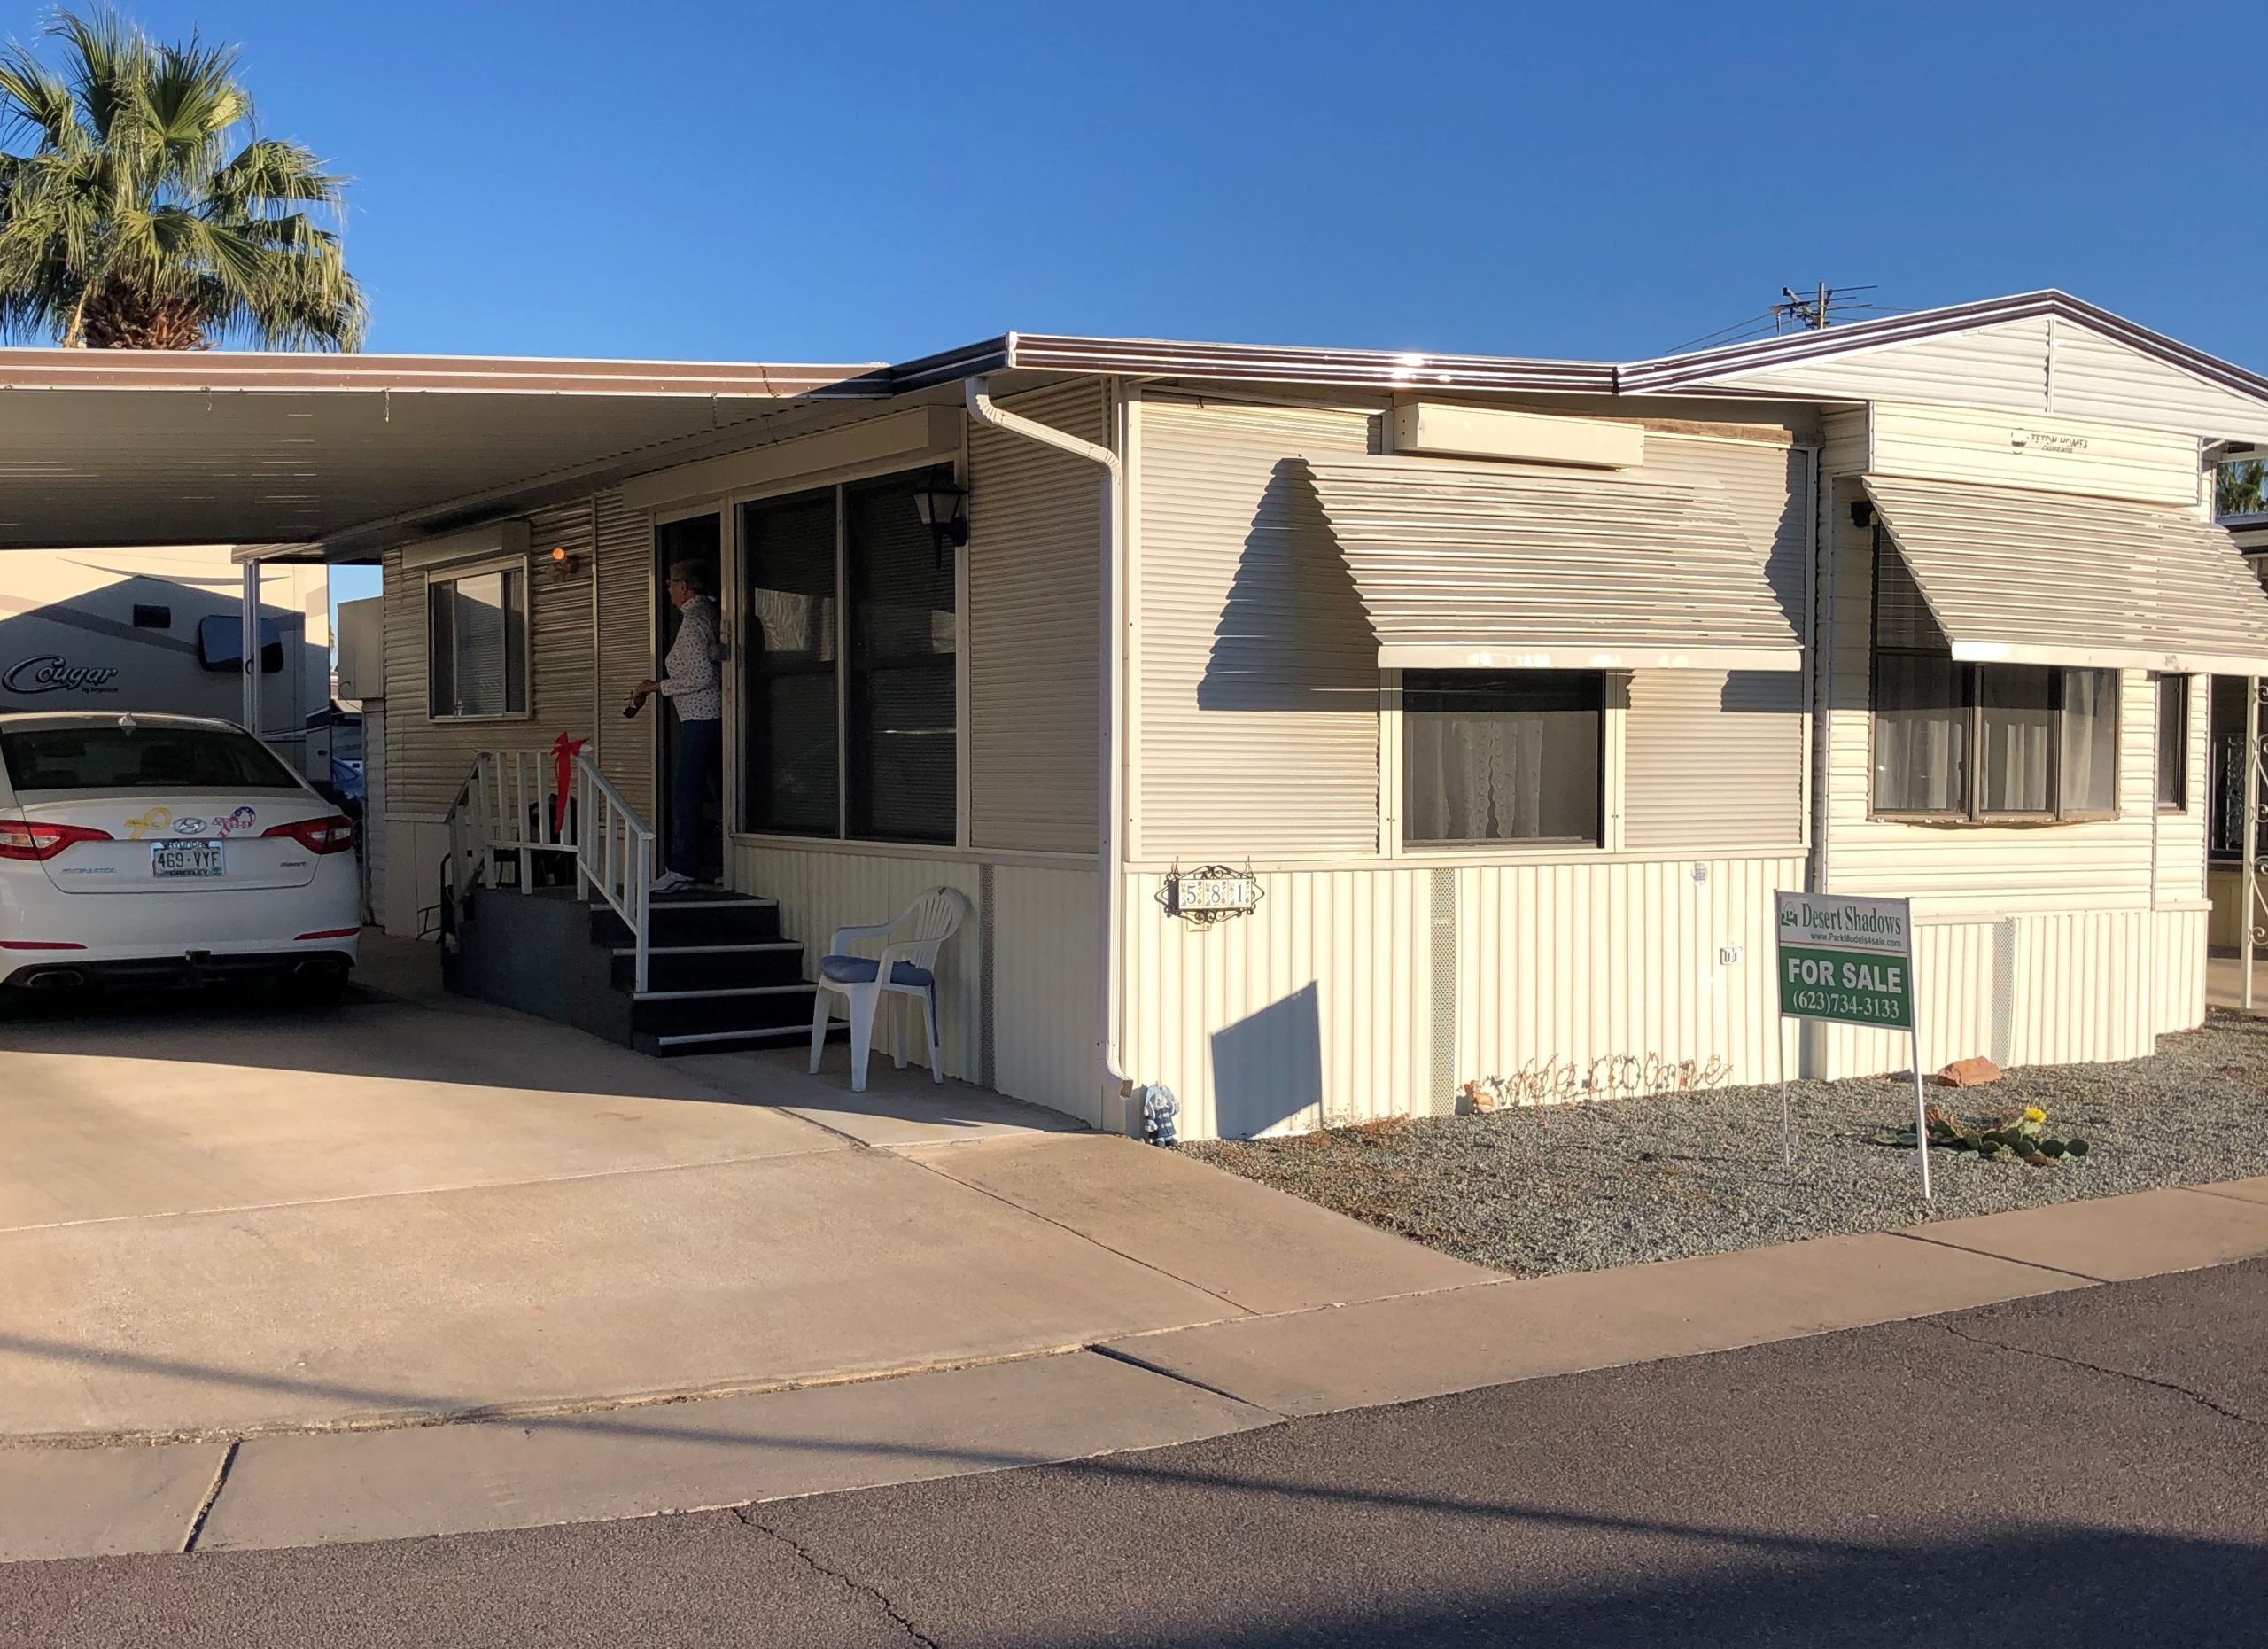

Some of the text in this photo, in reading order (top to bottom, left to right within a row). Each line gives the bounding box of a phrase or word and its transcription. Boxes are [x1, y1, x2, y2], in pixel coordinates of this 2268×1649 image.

[2, 655, 118, 694] Cougar
[1186, 884, 1243, 905] 581
[1801, 902, 1902, 936] Desert Shadows
[1787, 957, 1903, 994] FOR SALE
[1792, 989, 1900, 1020] (623)734-3133
